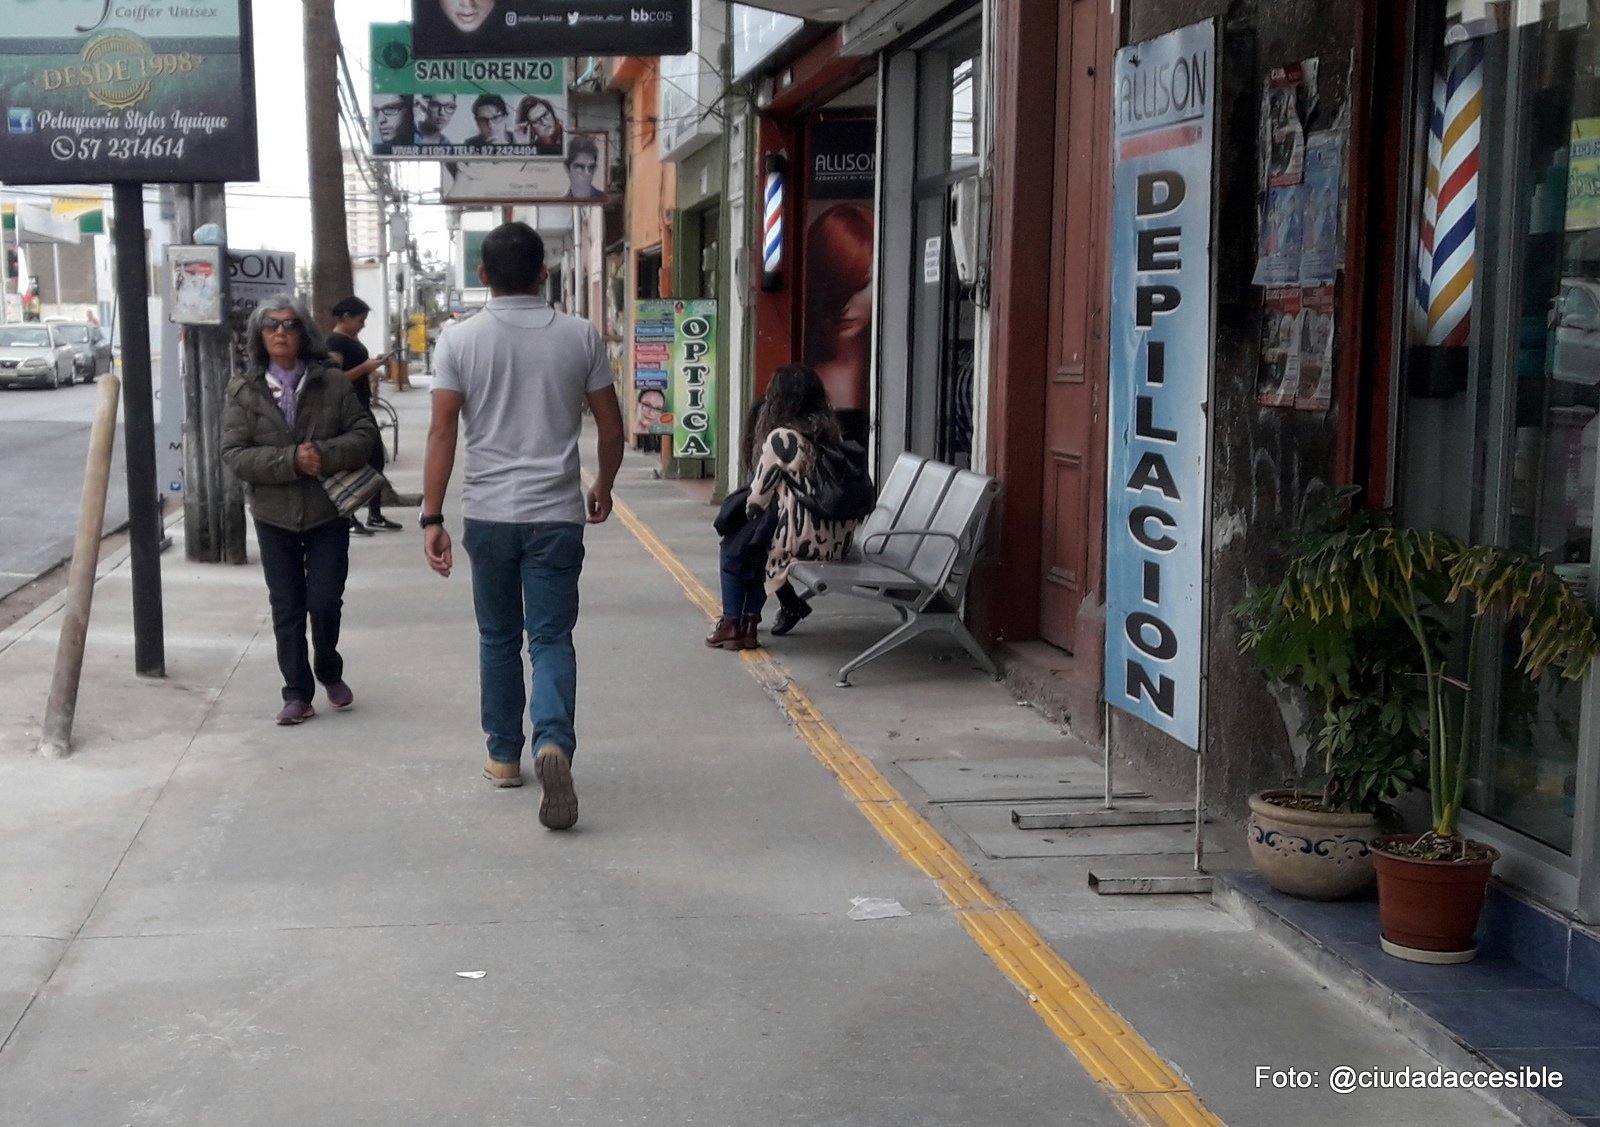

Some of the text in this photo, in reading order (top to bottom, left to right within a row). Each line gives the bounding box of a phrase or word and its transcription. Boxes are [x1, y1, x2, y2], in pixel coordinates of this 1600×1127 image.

[115, 6, 163, 21] Coiffer
[169, 5, 218, 18] Unisex
[630, 8, 673, 22] bbcos
[44, 51, 193, 90] DESDE 1998
[415, 59, 553, 81] SAN LORENZO
[1119, 49, 1207, 124] ALLISON
[37, 109, 229, 136] Peluqueria Stylos Iquique
[78, 136, 185, 160] 57 2314614
[680, 316, 710, 456] OPTICA
[1124, 169, 1187, 720] DEPILACION
